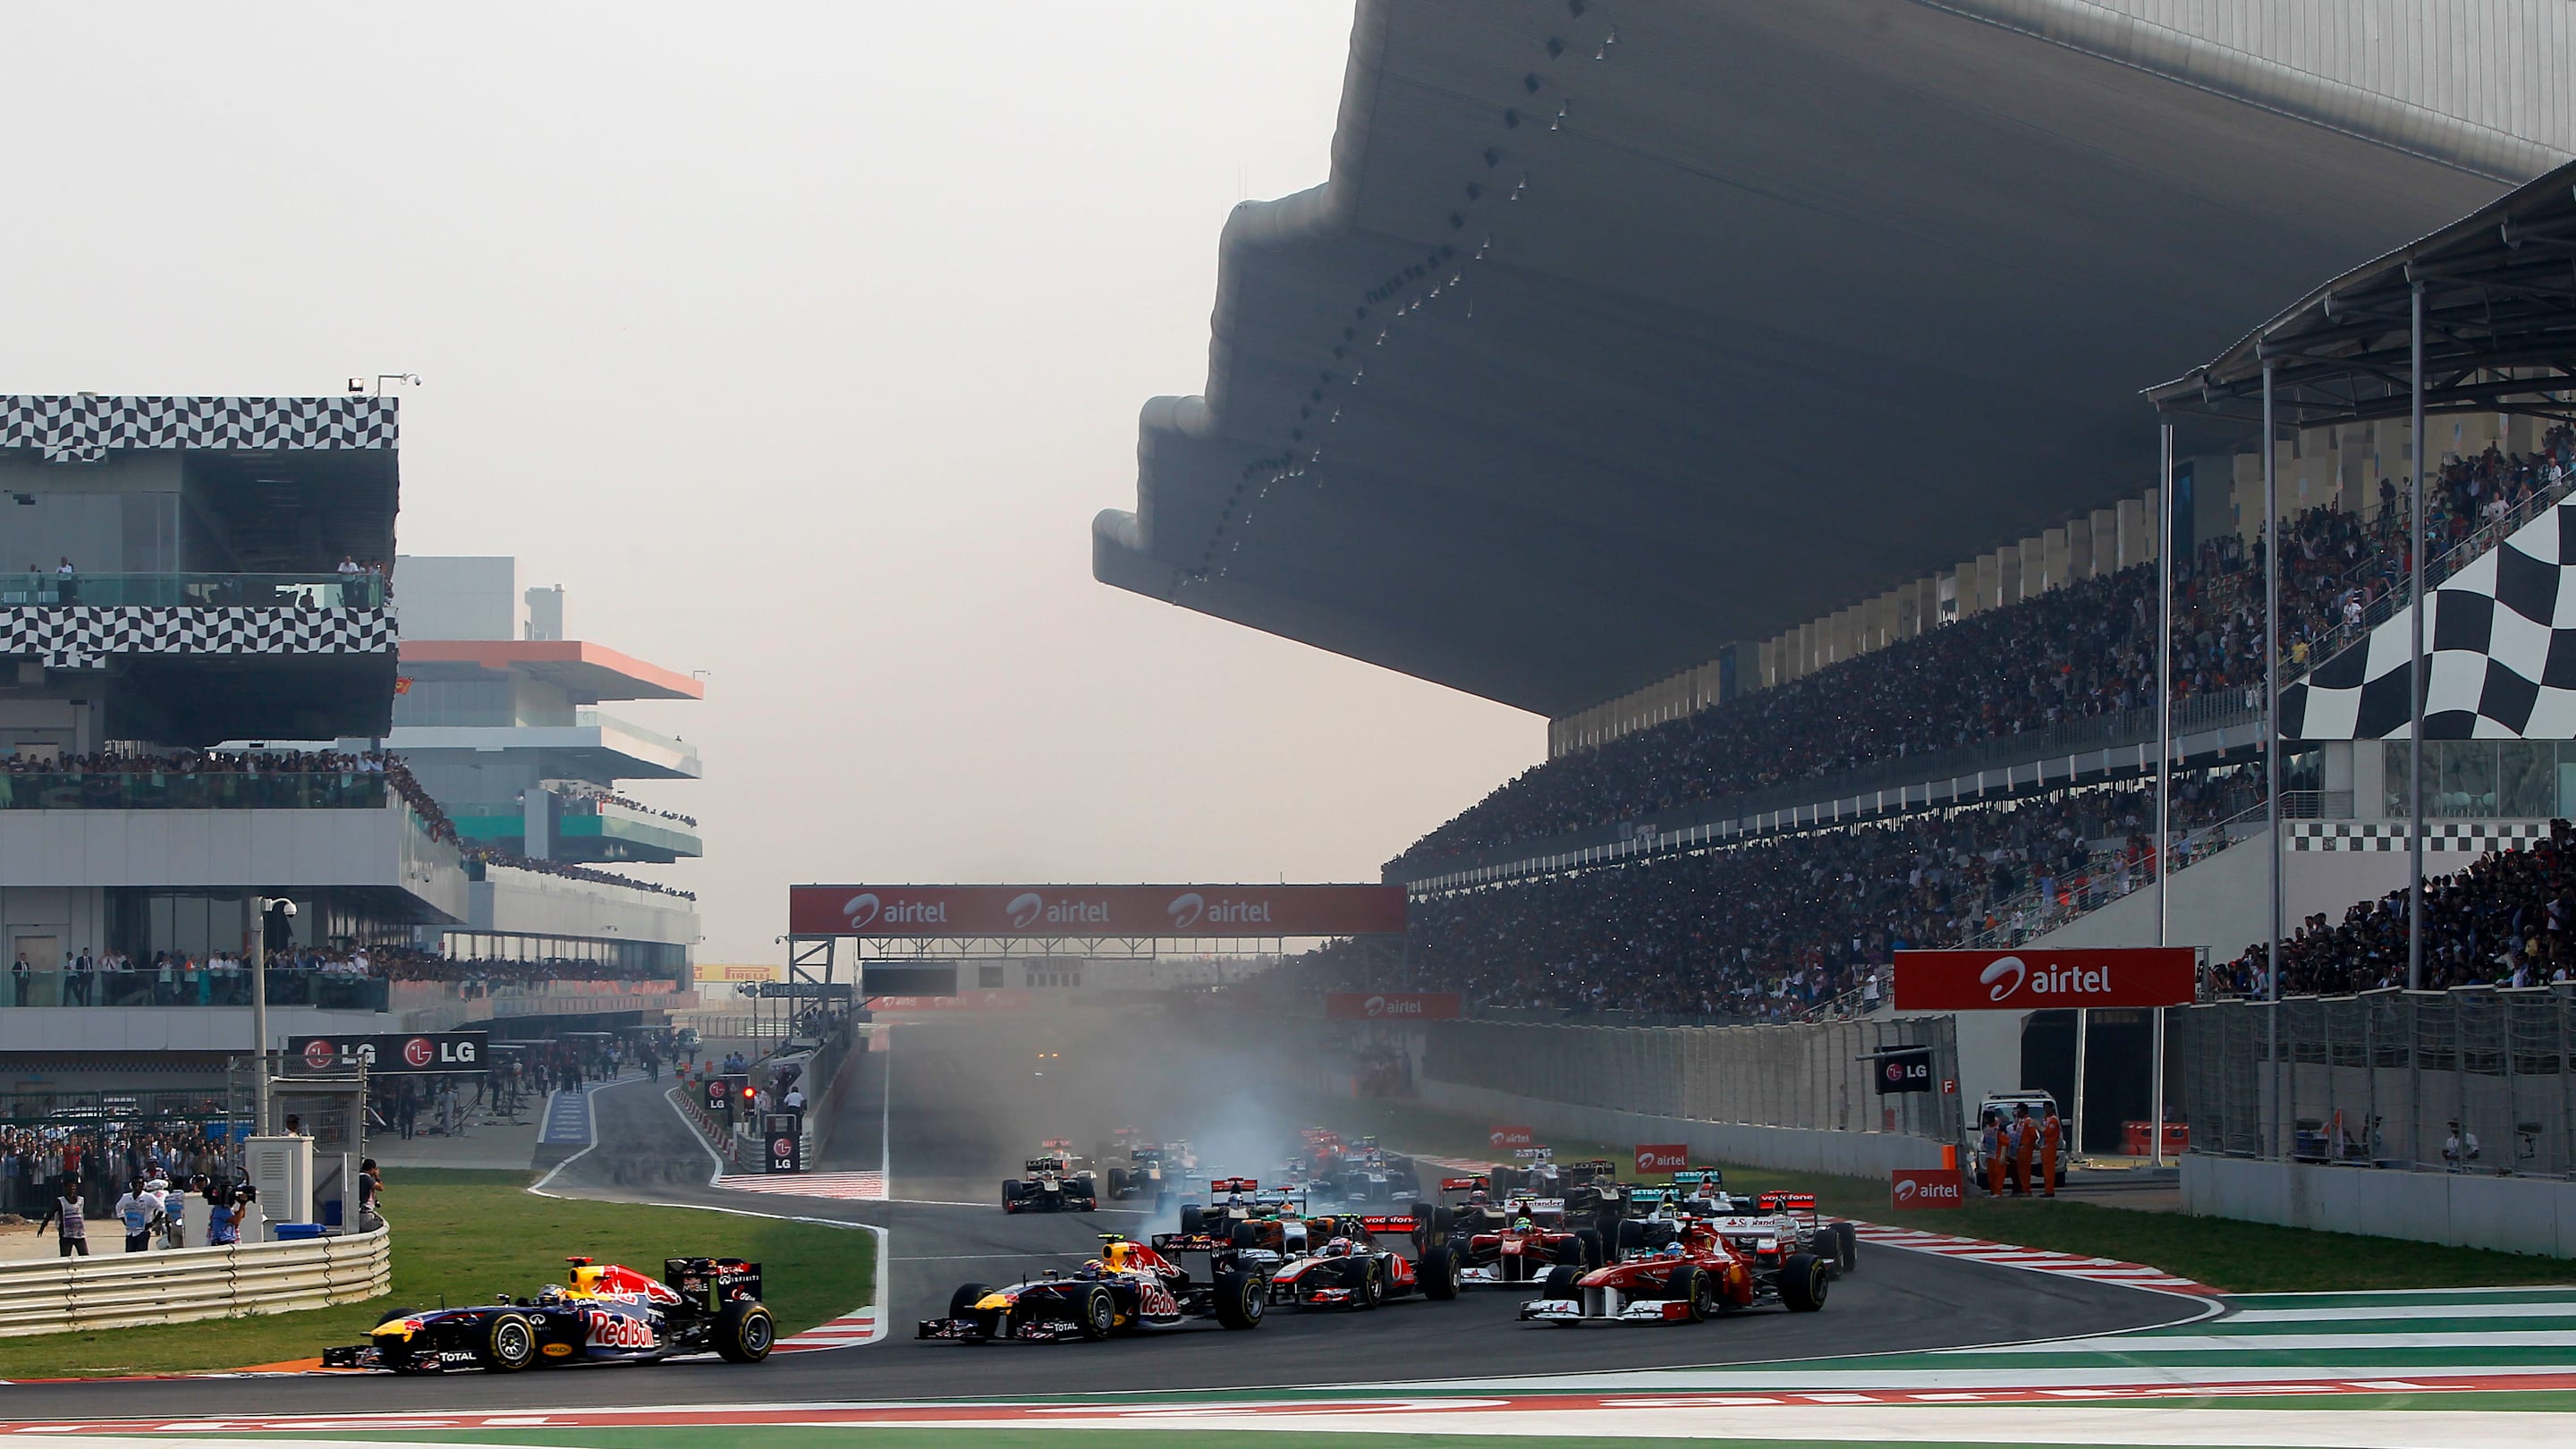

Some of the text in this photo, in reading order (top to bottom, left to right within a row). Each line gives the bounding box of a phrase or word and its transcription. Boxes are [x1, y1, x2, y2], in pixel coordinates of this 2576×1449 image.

[884, 900, 946, 923] airtel
[1047, 900, 1109, 923] airtel
[1208, 900, 1271, 923] airtel
[724, 966, 770, 979] PIRELLI
[2031, 964, 2111, 993] airtel
[1387, 999, 1422, 1013] airtel
[342, 1043, 376, 1063] LG
[441, 1041, 475, 1063] LG
[1907, 1064, 1927, 1078] LG
[1944, 1080, 1953, 1093] F
[710, 1100, 724, 1108] LG
[1506, 1134, 1530, 1143] airtel
[775, 1159, 791, 1169] LG
[1657, 1155, 1686, 1166] airtel
[1919, 1184, 1958, 1198] airtel
[1054, 1322, 1078, 1332] TOTAL
[439, 1352, 477, 1361] TOTAL
